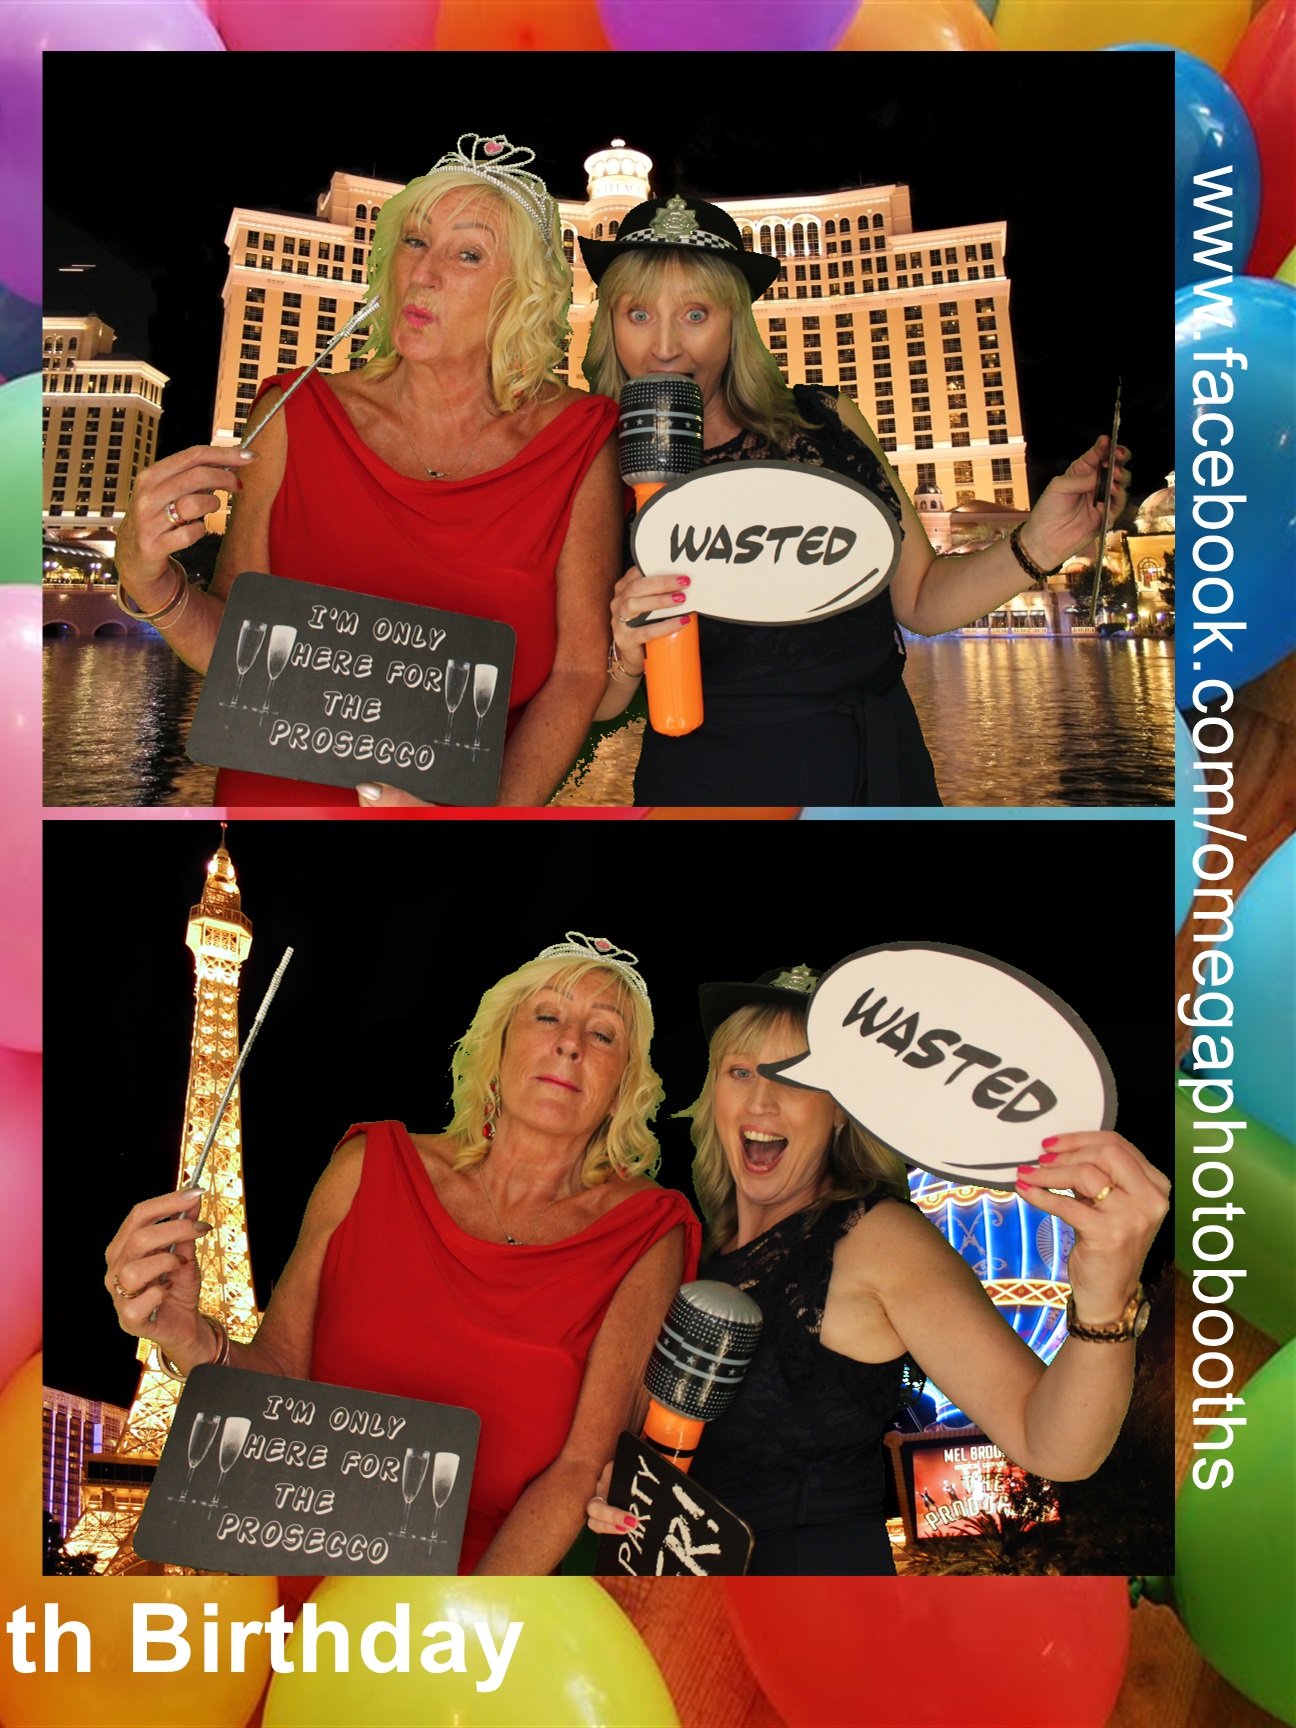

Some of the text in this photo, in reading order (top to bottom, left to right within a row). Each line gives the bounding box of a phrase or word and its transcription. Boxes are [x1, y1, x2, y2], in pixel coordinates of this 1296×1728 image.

[669, 523, 857, 566] WASTED
[307, 604, 447, 651] I'M ONLY
[290, 642, 443, 692] HERE FOR
[323, 690, 382, 722] THE
[269, 719, 435, 771] PROSECCO
[842, 987, 1058, 1123] WASTED
[262, 1395, 406, 1440] I'M ONLY
[243, 1434, 401, 1483] HERE FOR
[944, 1447, 967, 1463] MEL
[275, 1483, 336, 1515] THE
[217, 1513, 389, 1565] PROSECCO
